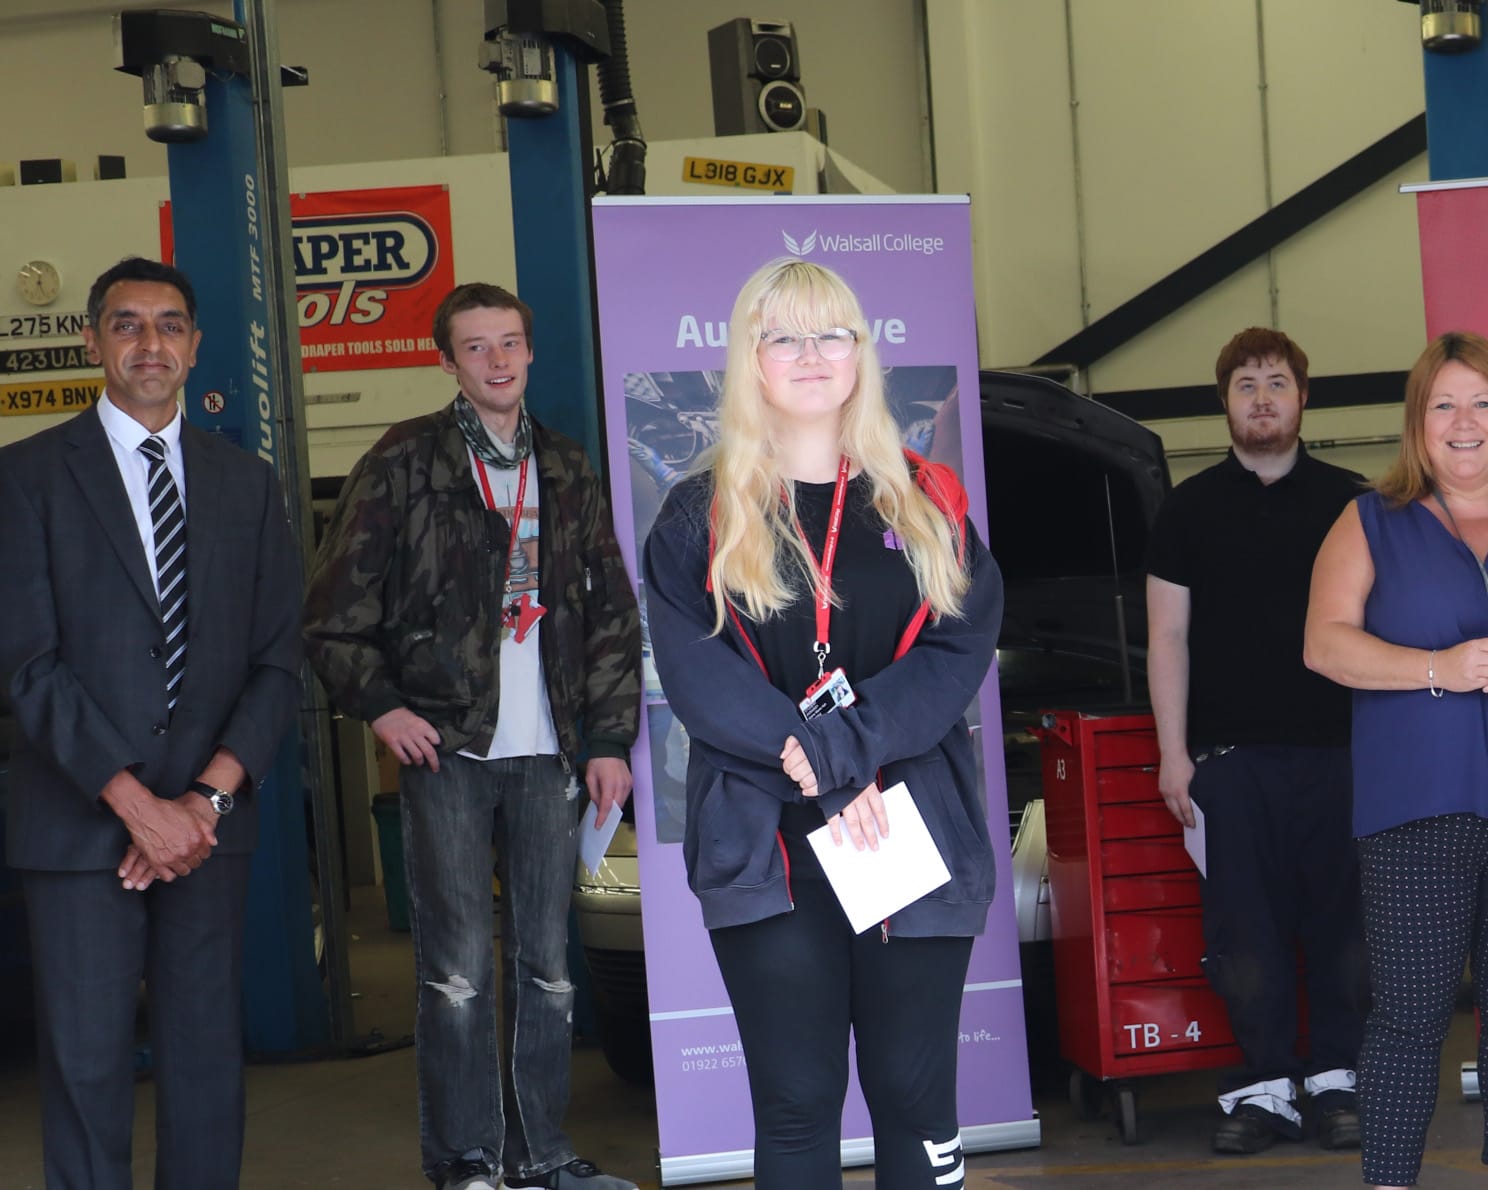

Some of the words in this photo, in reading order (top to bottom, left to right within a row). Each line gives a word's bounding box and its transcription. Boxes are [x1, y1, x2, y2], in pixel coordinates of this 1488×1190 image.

[690, 161, 738, 182] L318
[743, 167, 787, 187] GJX
[245, 173, 259, 240] 3000
[819, 233, 881, 252] Walsall
[884, 233, 944, 255] College
[249, 244, 262, 301] MTF
[56, 315, 89, 335] KN
[301, 342, 345, 358] DRAPER
[347, 339, 383, 355] TOOLS
[385, 338, 415, 353] SOLD
[7, 390, 58, 410] X974
[1056, 759, 1066, 781] A3
[1123, 1023, 1161, 1049] TB
[1185, 1020, 1202, 1043] 4
[682, 1058, 718, 1072] 01922
